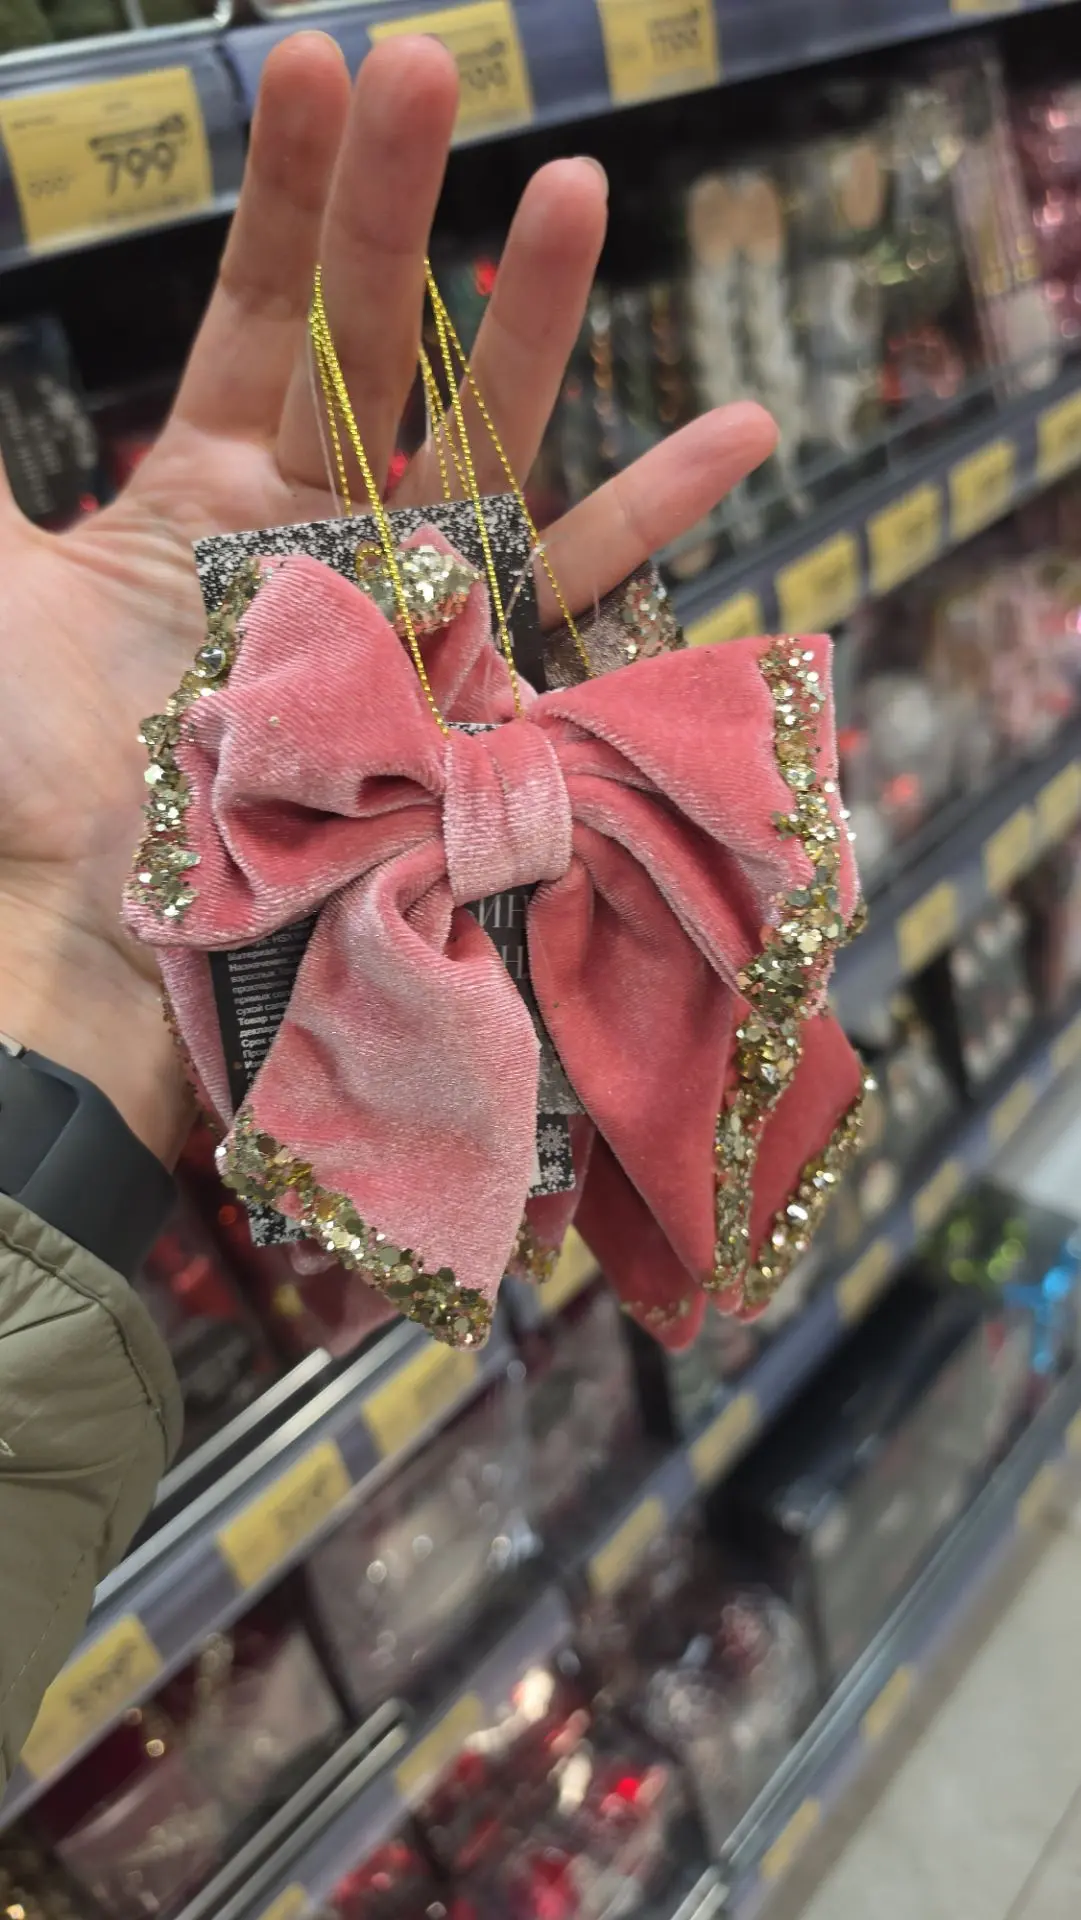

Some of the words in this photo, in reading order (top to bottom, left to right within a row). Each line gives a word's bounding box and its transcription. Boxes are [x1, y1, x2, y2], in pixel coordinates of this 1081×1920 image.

[98, 141, 178, 197] 799
[237, 1015, 269, 1026] Товар
[241, 1038, 267, 1048] Срок
